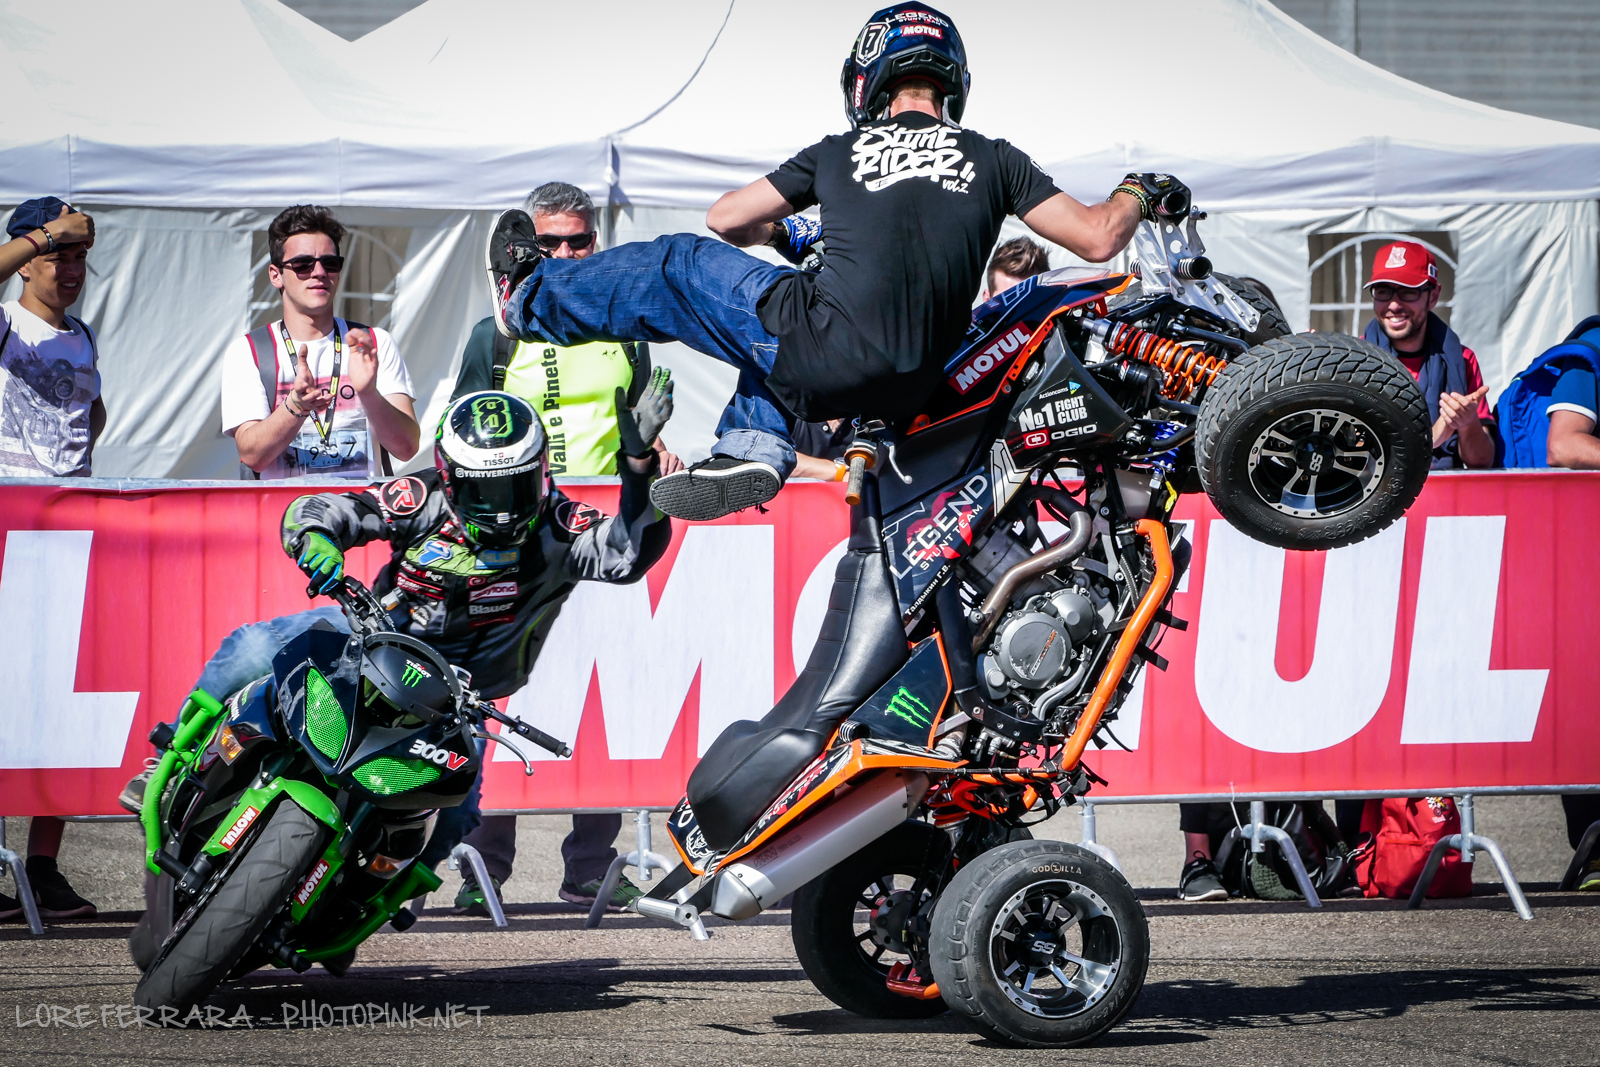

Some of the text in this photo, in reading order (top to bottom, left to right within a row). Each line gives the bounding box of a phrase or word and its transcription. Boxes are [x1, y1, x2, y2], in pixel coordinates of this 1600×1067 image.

[886, 12, 949, 28] LEGEND
[903, 26, 941, 37] MOTUL
[956, 328, 1031, 391] MOTUL
[1038, 386, 1069, 400] Actioncams
[541, 348, 568, 475] Valli e Pinete
[1054, 395, 1085, 413] FIGHT
[1057, 406, 1088, 425] CLUB
[1051, 423, 1097, 440] OGIO
[483, 457, 515, 467] TISSOT
[889, 475, 989, 580] LEGEND
[920, 504, 984, 571] STUNT TEAM
[905, 579, 939, 616] Талдыкин
[468, 602, 515, 615] Blauer
[405, 659, 432, 678] TISSOT
[409, 739, 469, 771] 300V
[221, 807, 257, 848] MOTUL
[298, 863, 329, 904] MOTUL
